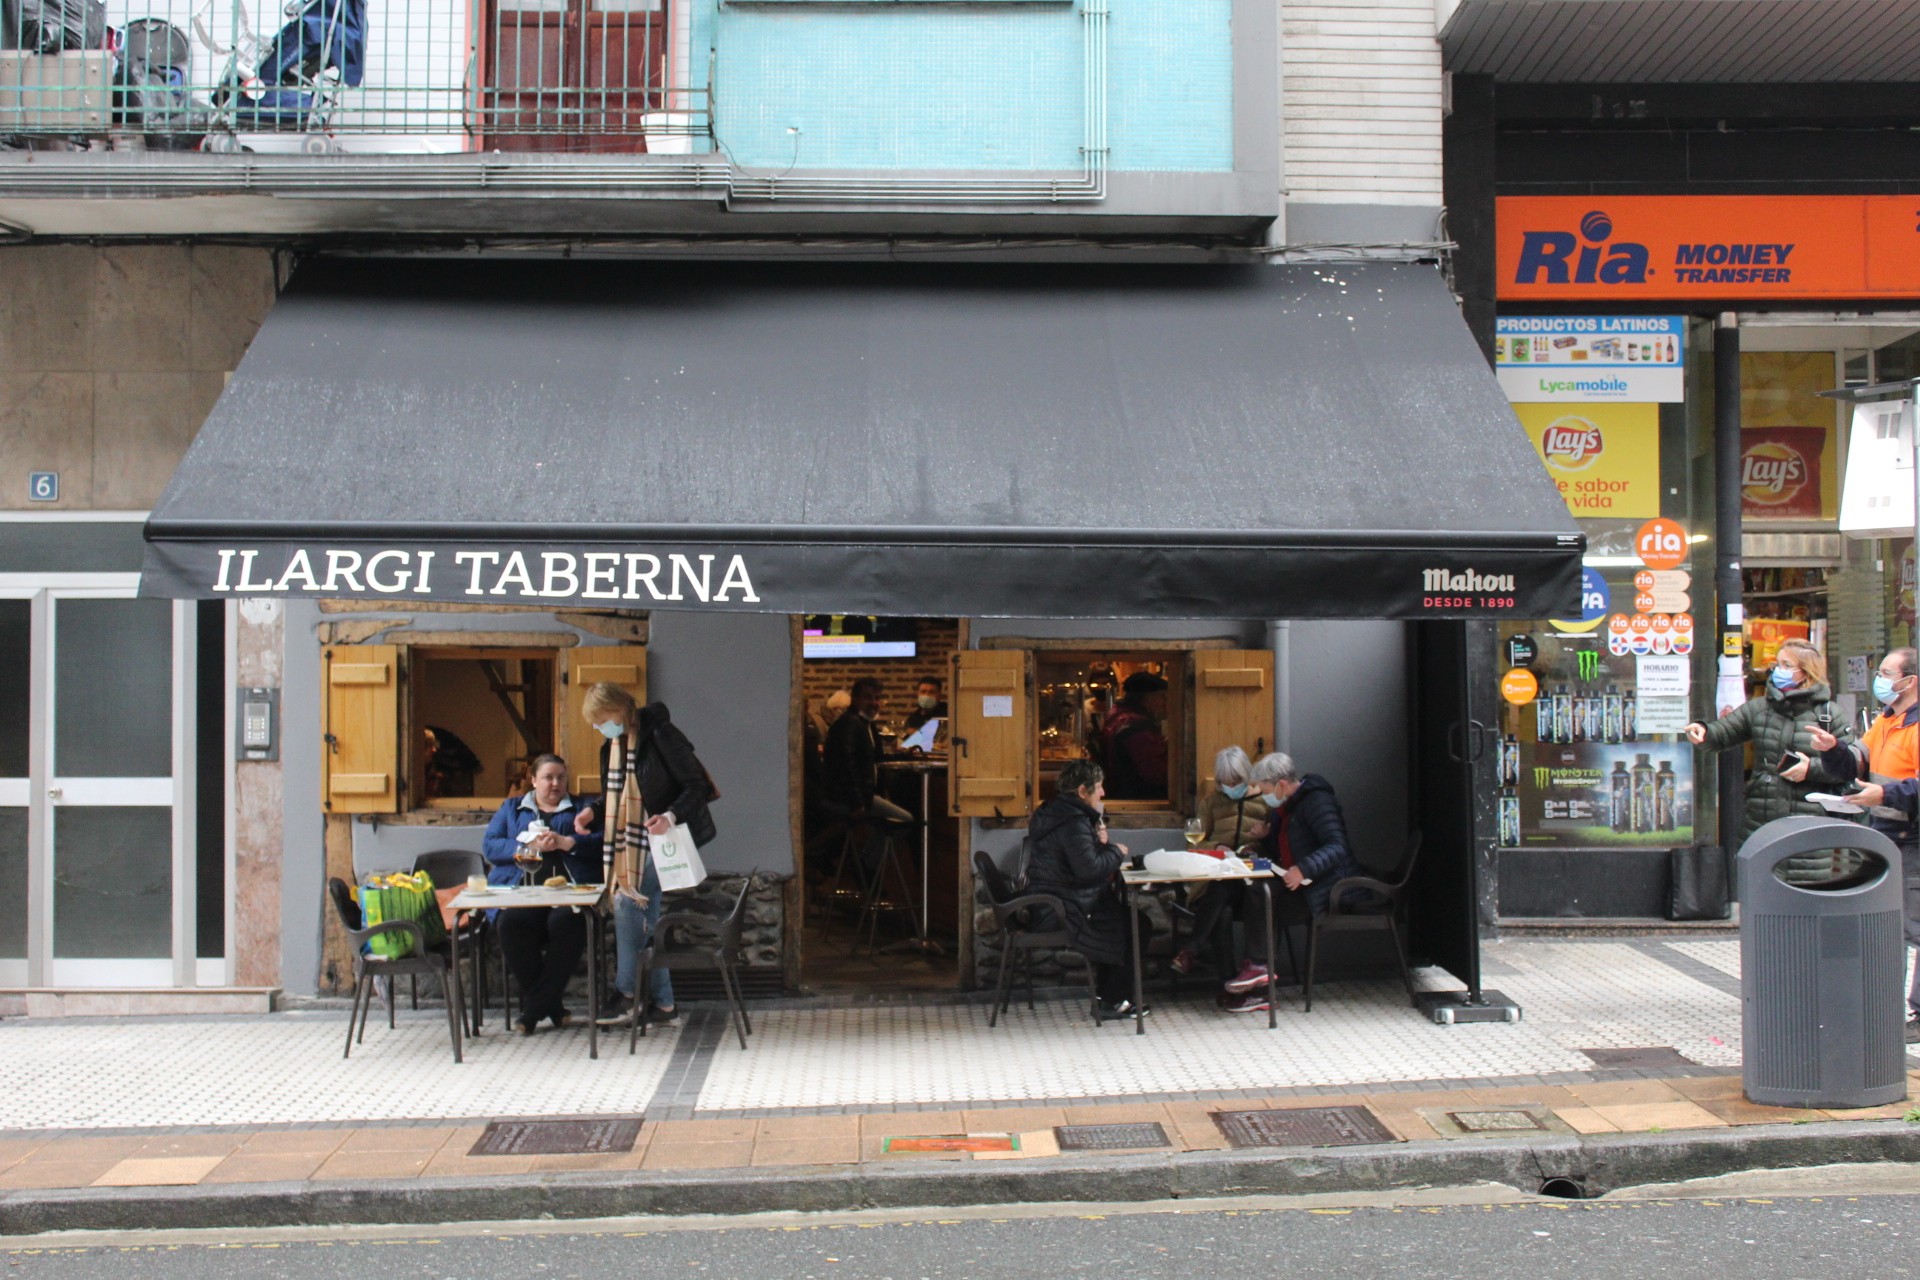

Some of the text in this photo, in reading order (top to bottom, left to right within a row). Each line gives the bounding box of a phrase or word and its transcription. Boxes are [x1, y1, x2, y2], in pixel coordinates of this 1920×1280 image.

[1515, 211, 1649, 284] Ria
[1674, 244, 1795, 265] MONEY
[1674, 268, 1792, 283] TRANSFER
[1497, 318, 1670, 332] PRODUCTOS LATINOS
[1539, 378, 1628, 393] Lycamobile
[1546, 428, 1599, 461] Lay's
[1742, 455, 1801, 493] Lay's
[37, 476, 50, 497] 6
[1575, 478, 1630, 492] sabor
[1573, 494, 1613, 508] vida
[1641, 525, 1681, 551] ria
[212, 548, 761, 603] ILARGI TABERNA
[1422, 567, 1516, 592] Mahou
[1636, 573, 1653, 585] ria
[1423, 597, 1515, 608] DESDE 1890
[1636, 594, 1653, 605] ria
[1611, 615, 1691, 627] ria ria ria ria
[1643, 664, 1679, 673] HORARIO
[1551, 768, 1604, 777] MONSTER
